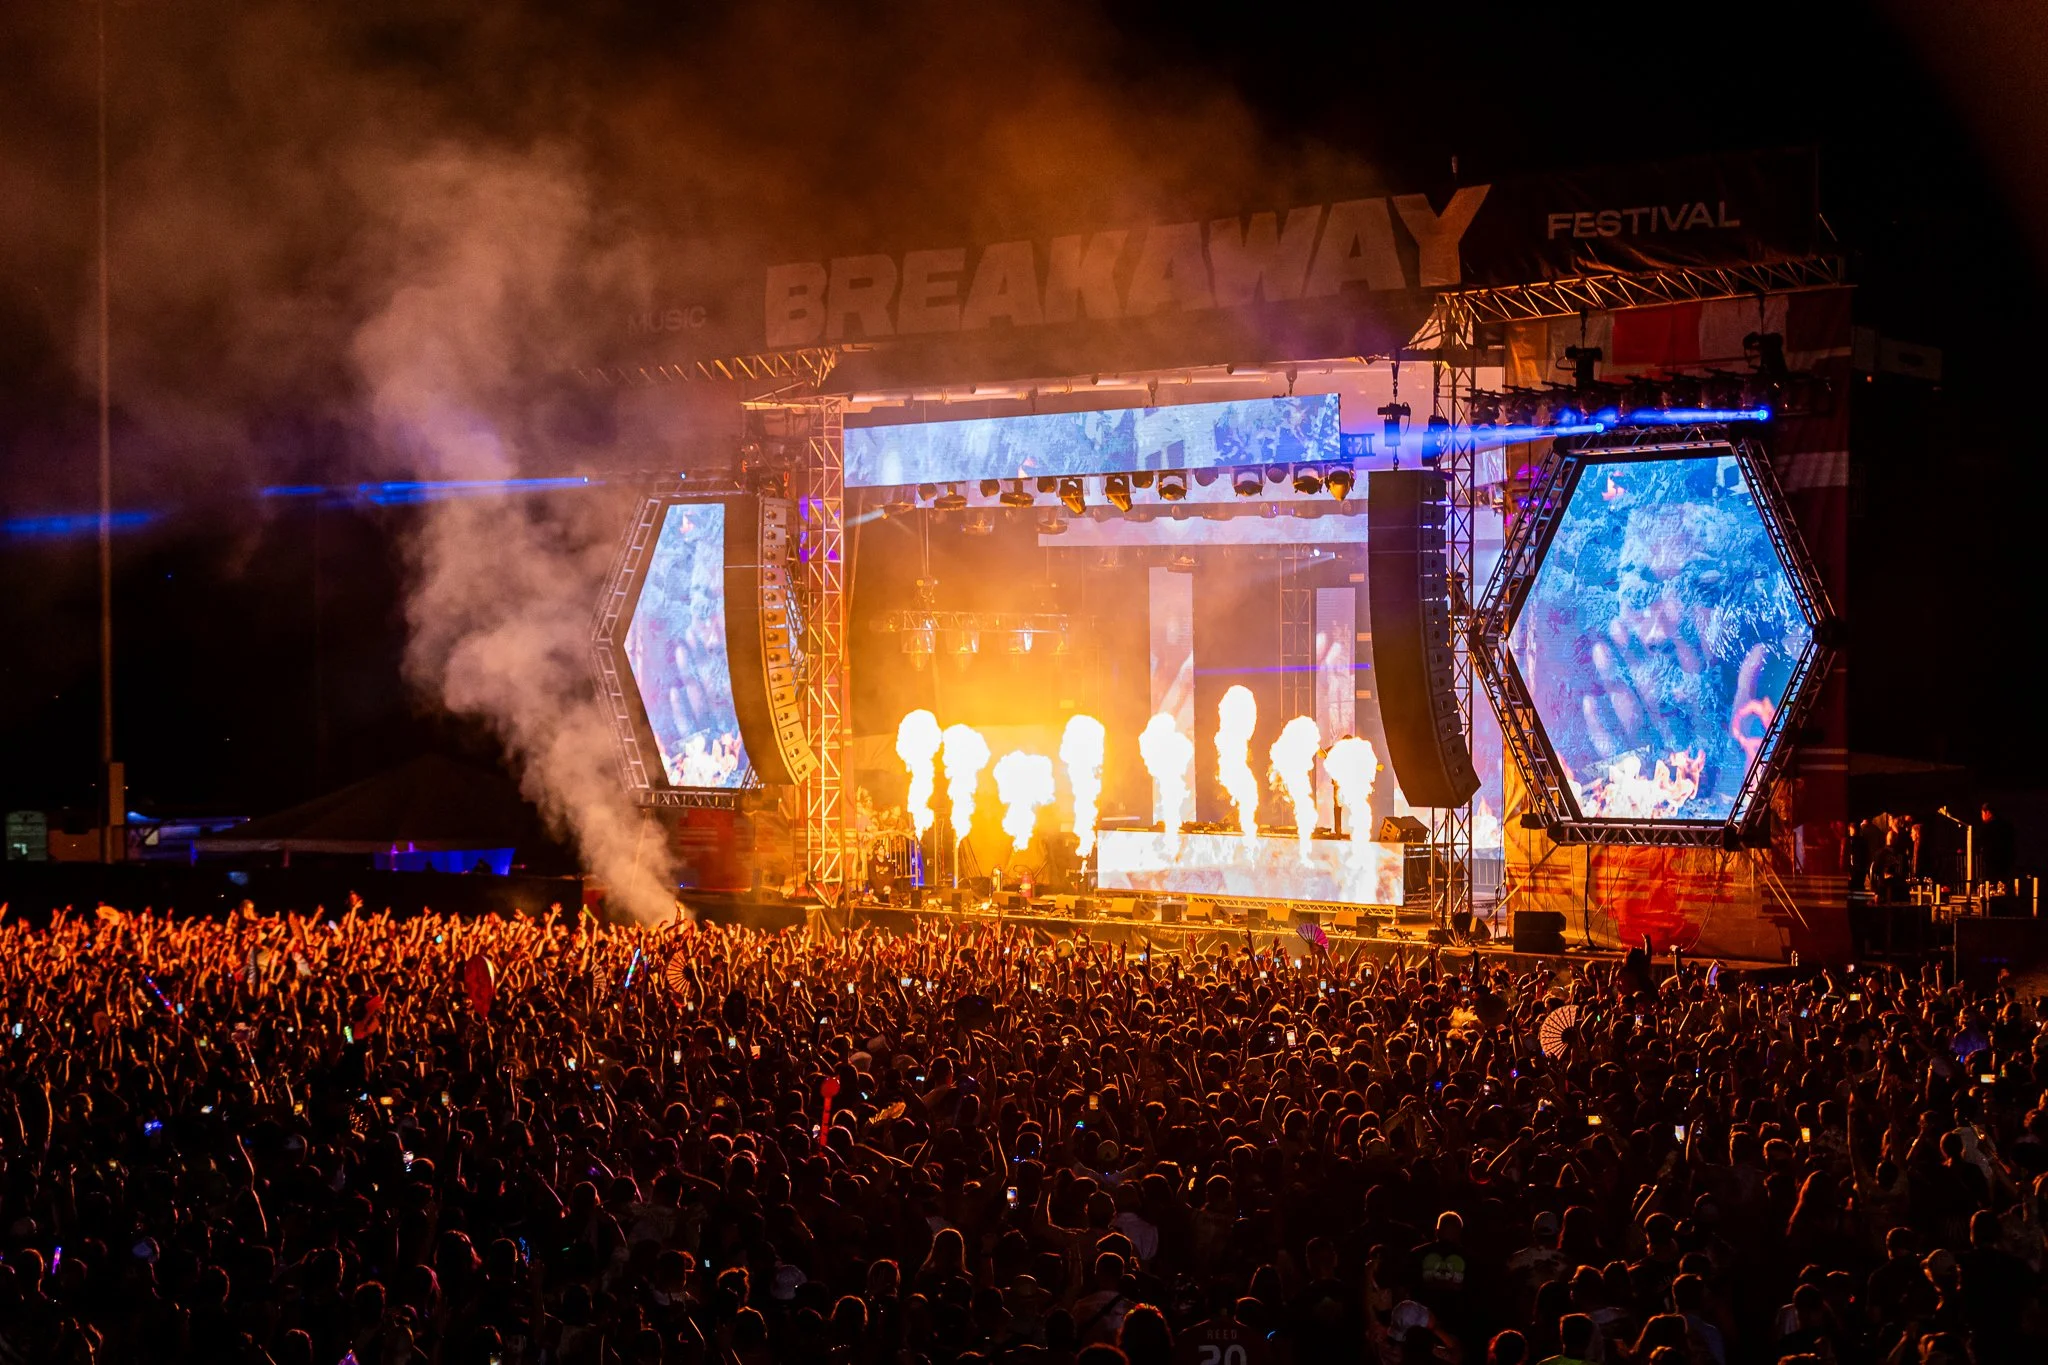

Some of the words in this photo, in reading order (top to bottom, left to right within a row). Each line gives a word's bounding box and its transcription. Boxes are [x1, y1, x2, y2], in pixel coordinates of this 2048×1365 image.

[627, 305, 707, 334] MUSIC
[766, 185, 1491, 348] BREAKAWAY
[1547, 201, 1741, 240] FESTIVAL
